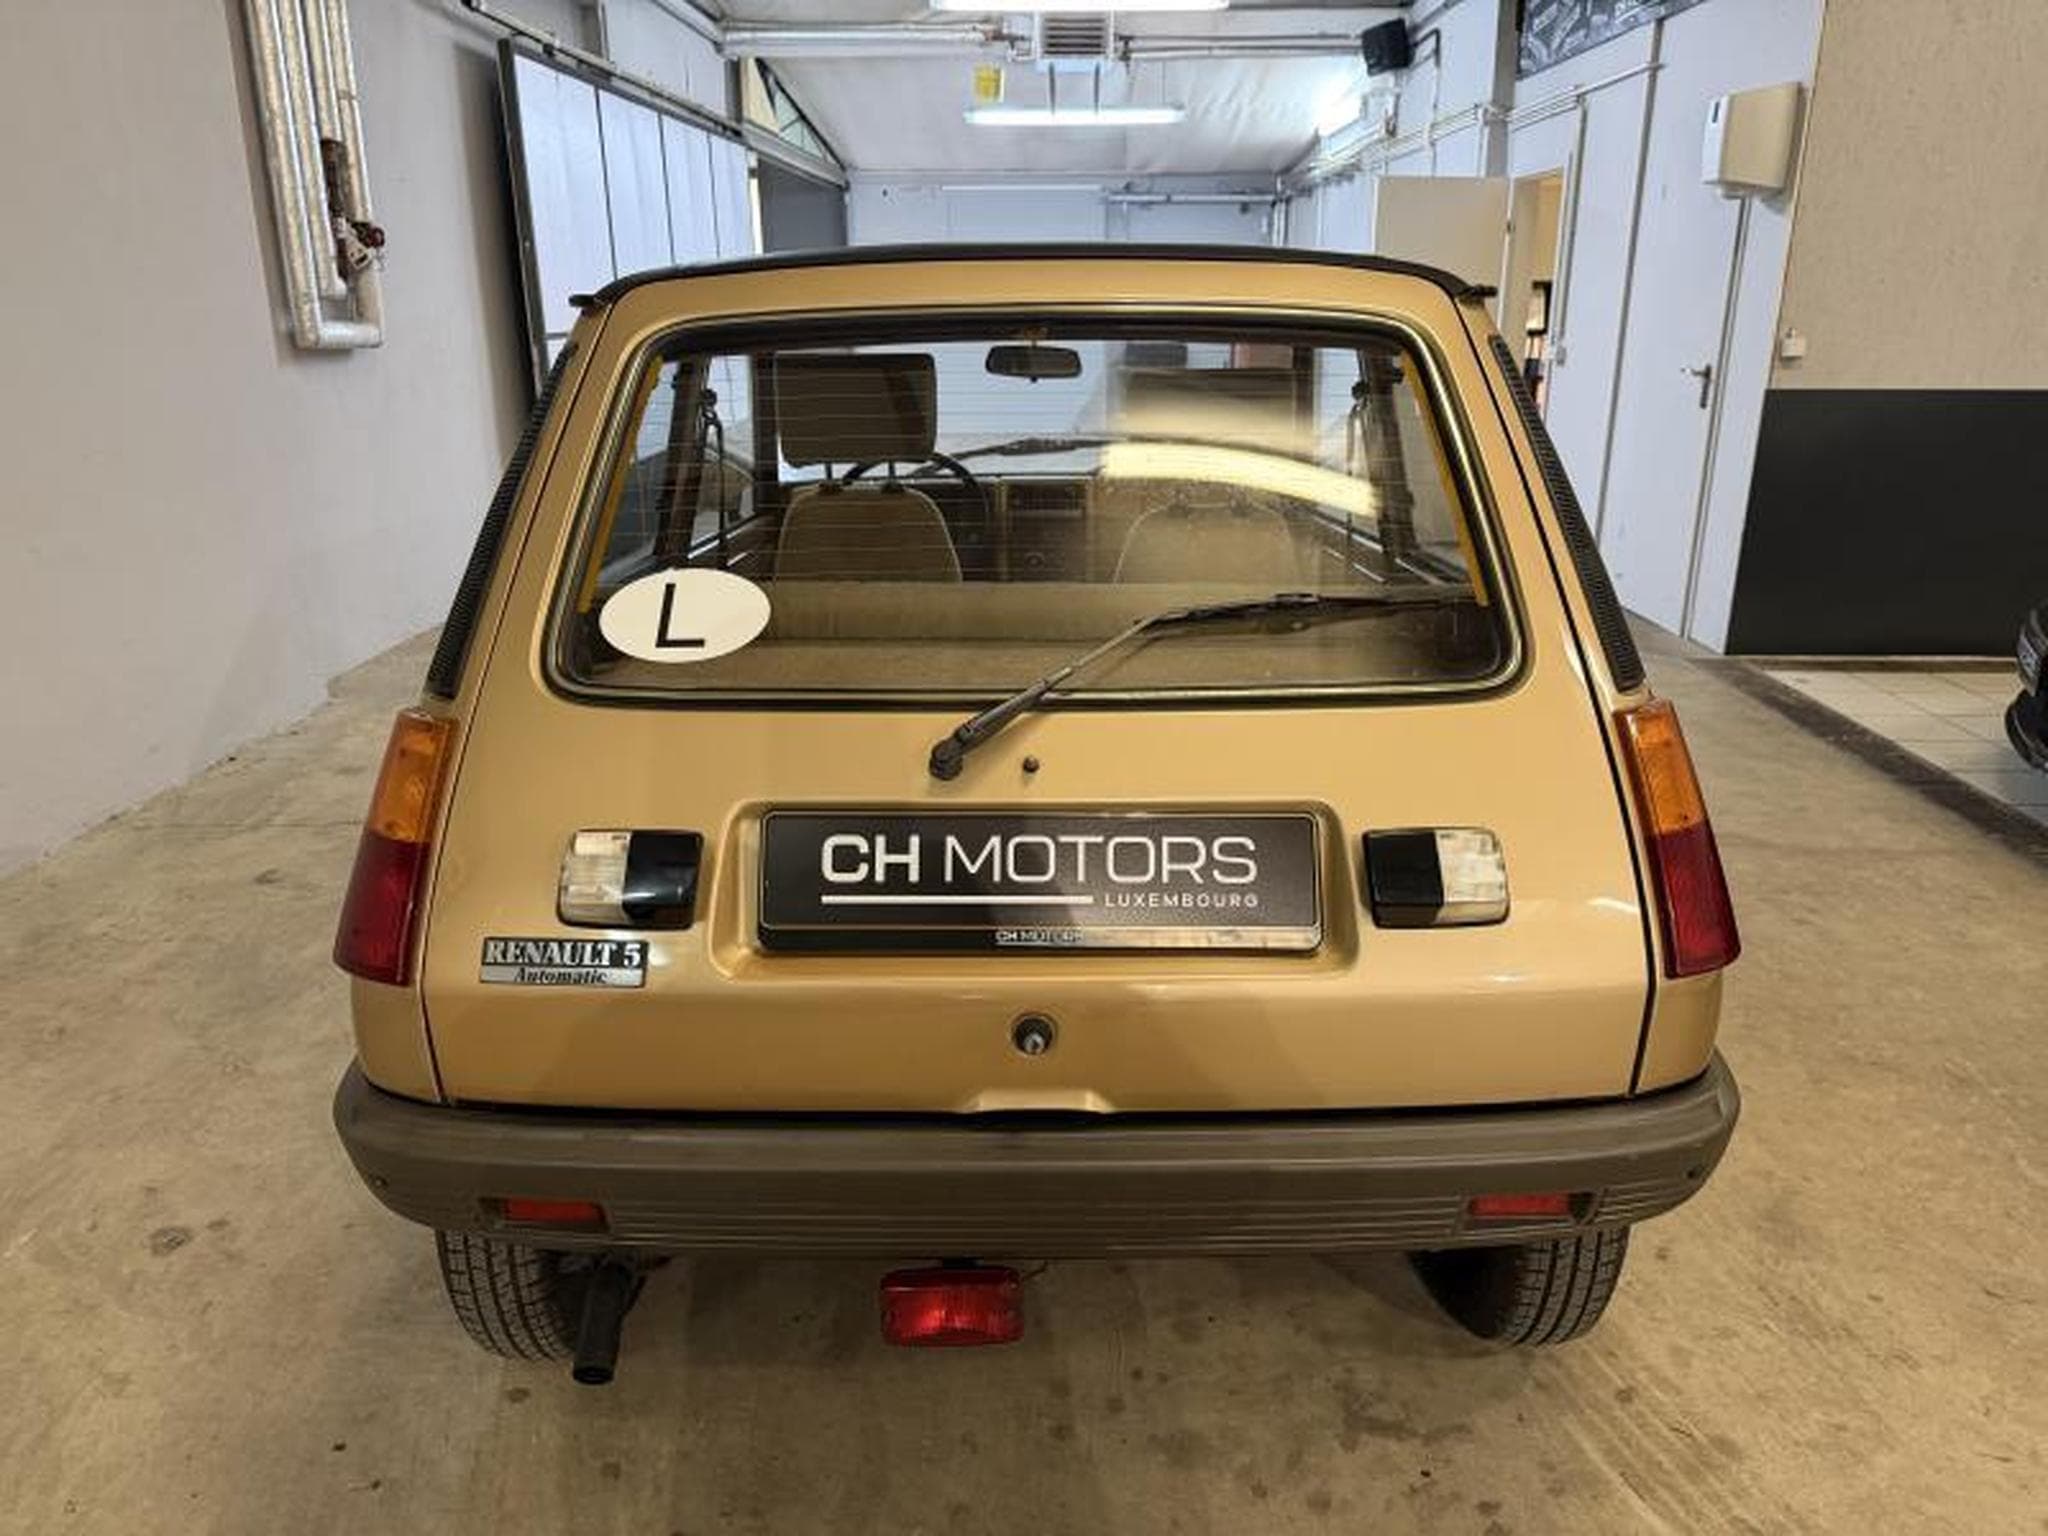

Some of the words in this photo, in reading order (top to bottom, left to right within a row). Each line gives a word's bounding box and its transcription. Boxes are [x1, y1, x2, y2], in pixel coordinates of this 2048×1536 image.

[656, 583, 705, 648] L
[821, 834, 919, 883] CH
[944, 835, 1257, 883] MOTORS
[1104, 893, 1258, 908] LUXEMBOURG
[486, 941, 617, 966] RENAULT
[623, 943, 641, 966] 5
[514, 967, 608, 984] Automatic
